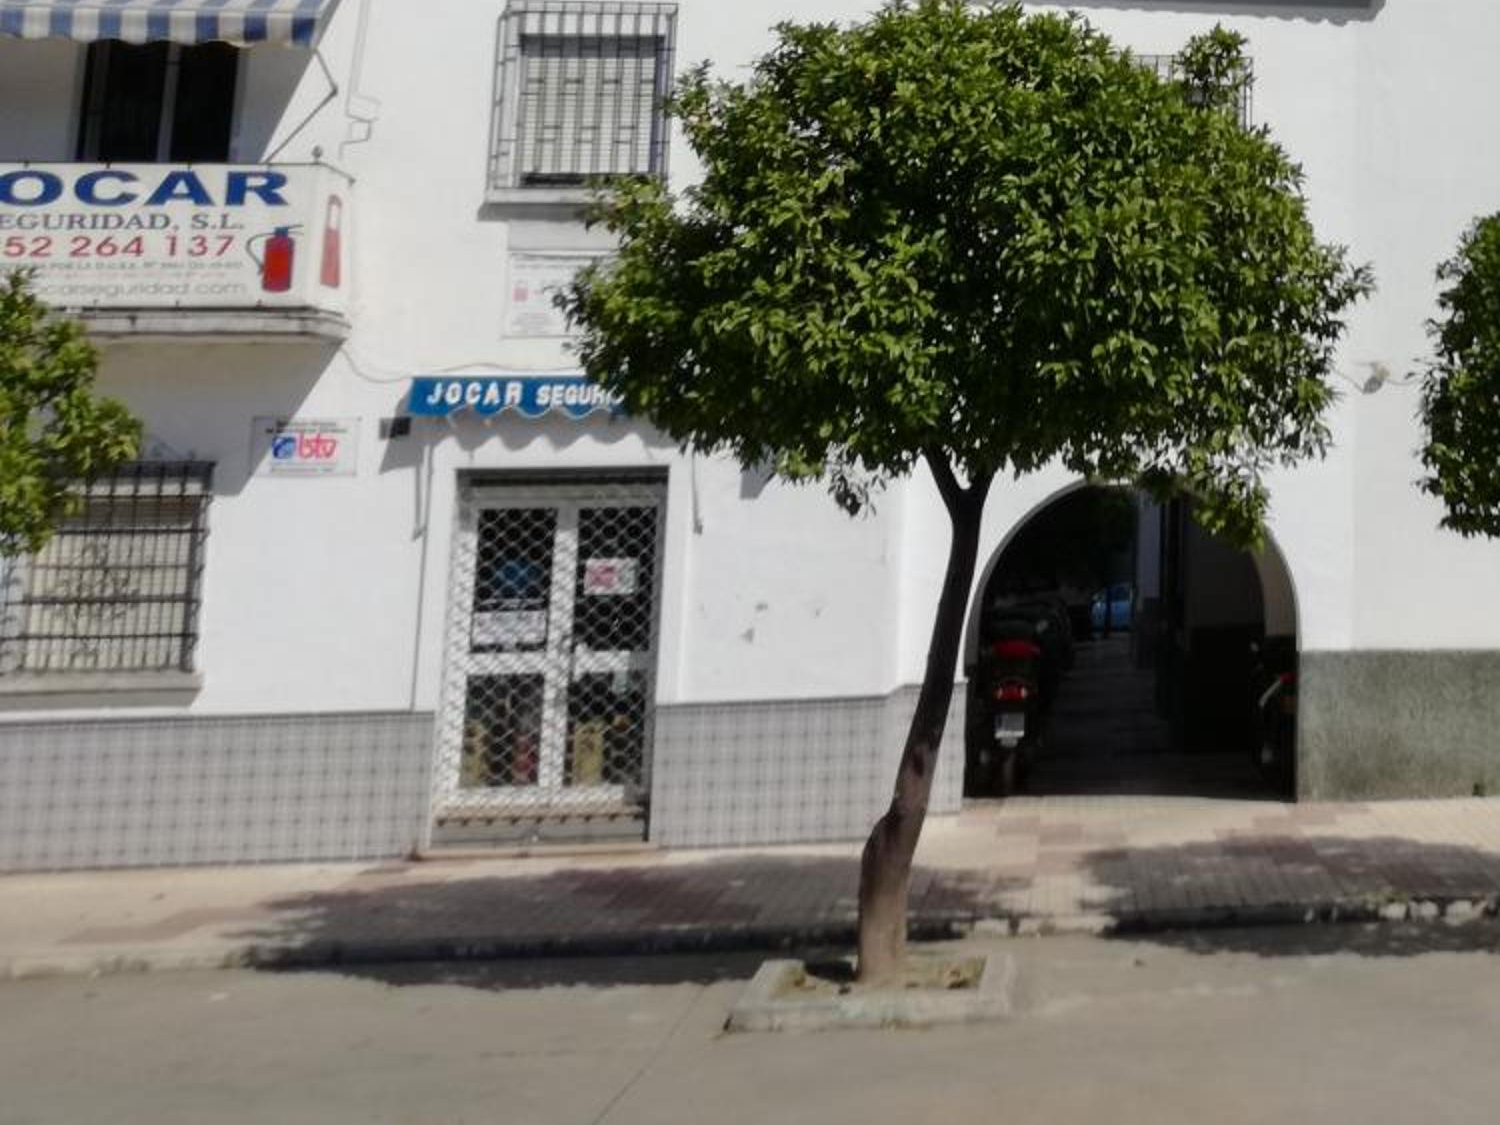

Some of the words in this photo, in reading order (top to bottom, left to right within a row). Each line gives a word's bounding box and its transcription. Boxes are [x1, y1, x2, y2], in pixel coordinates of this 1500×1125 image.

[0, 170, 288, 206] OCAR
[191, 213, 244, 230] S.L.
[4, 236, 51, 257] 52
[70, 235, 144, 257] 264
[166, 235, 235, 257] 137
[427, 381, 523, 405] JOCAR
